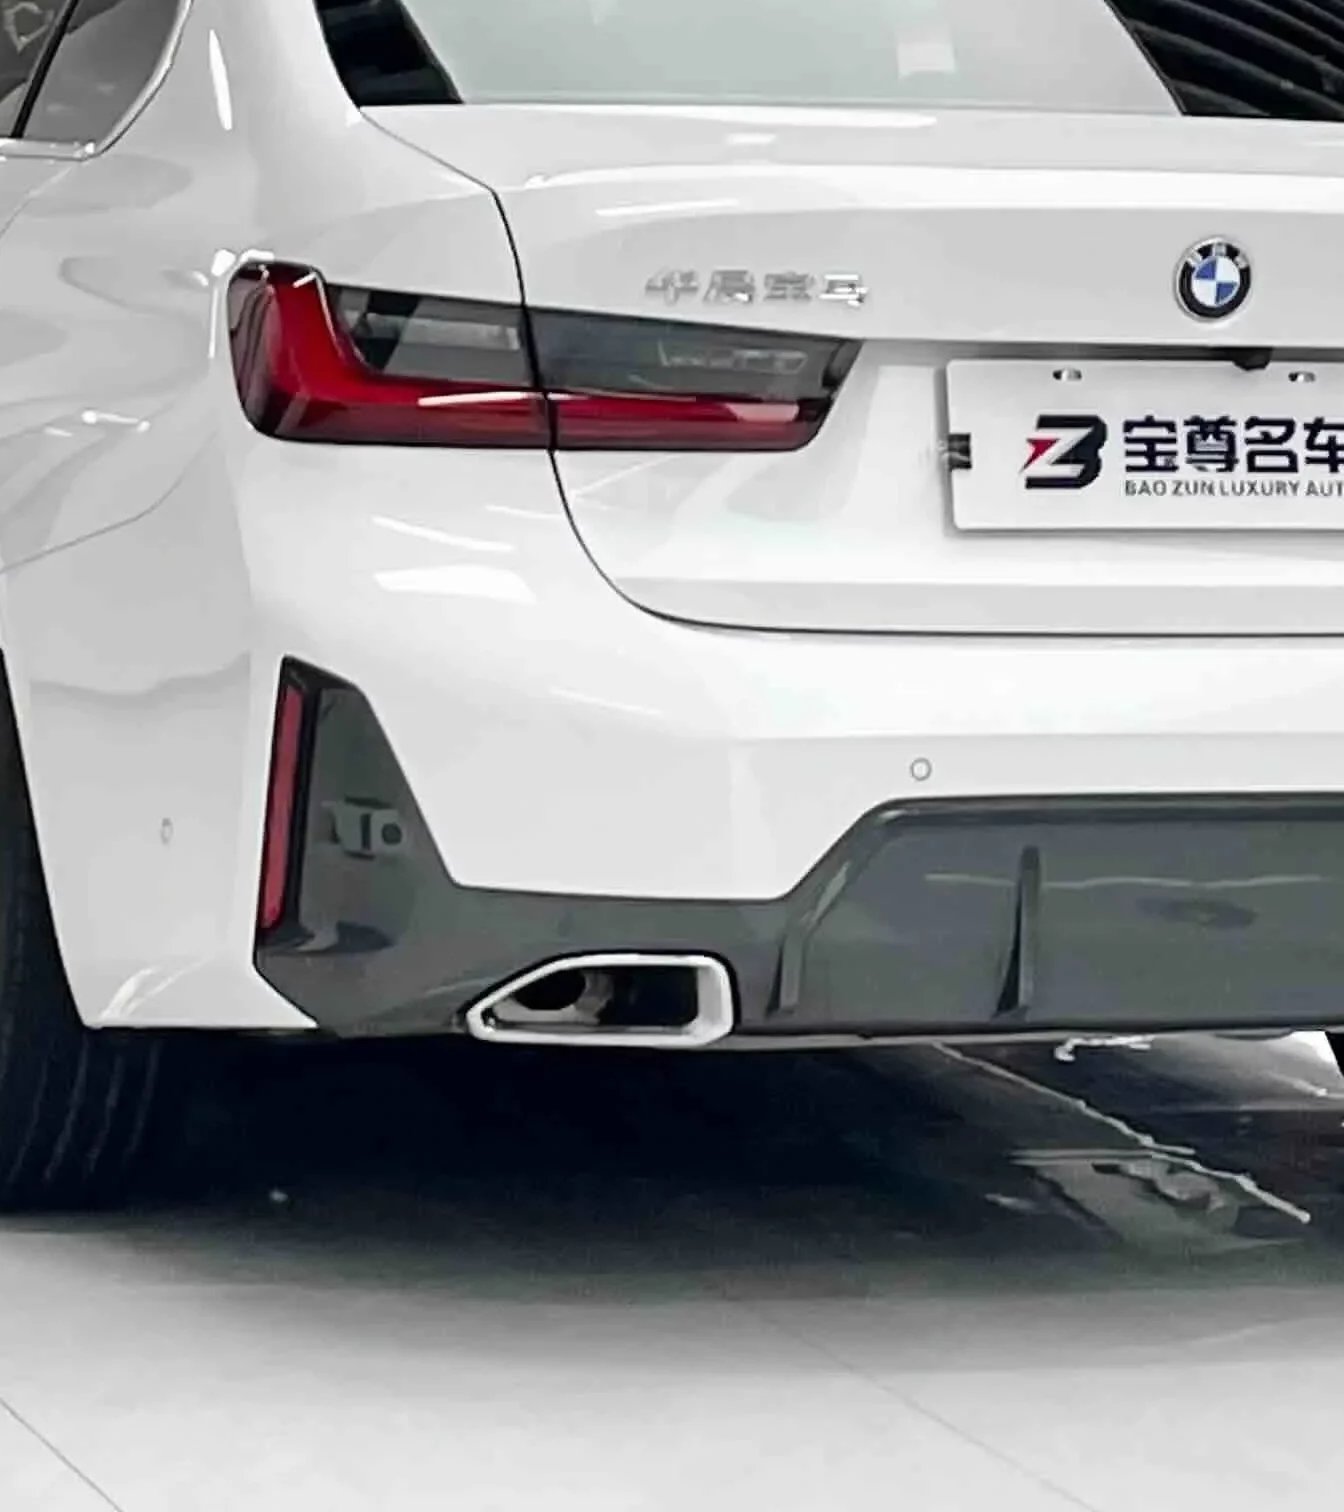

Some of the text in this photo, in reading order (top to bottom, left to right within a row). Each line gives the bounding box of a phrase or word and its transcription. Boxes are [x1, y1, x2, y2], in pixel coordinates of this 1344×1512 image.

[1124, 479, 1167, 497] BAO
[1171, 479, 1216, 497] ZUN
[1218, 479, 1301, 497] LUXURY
